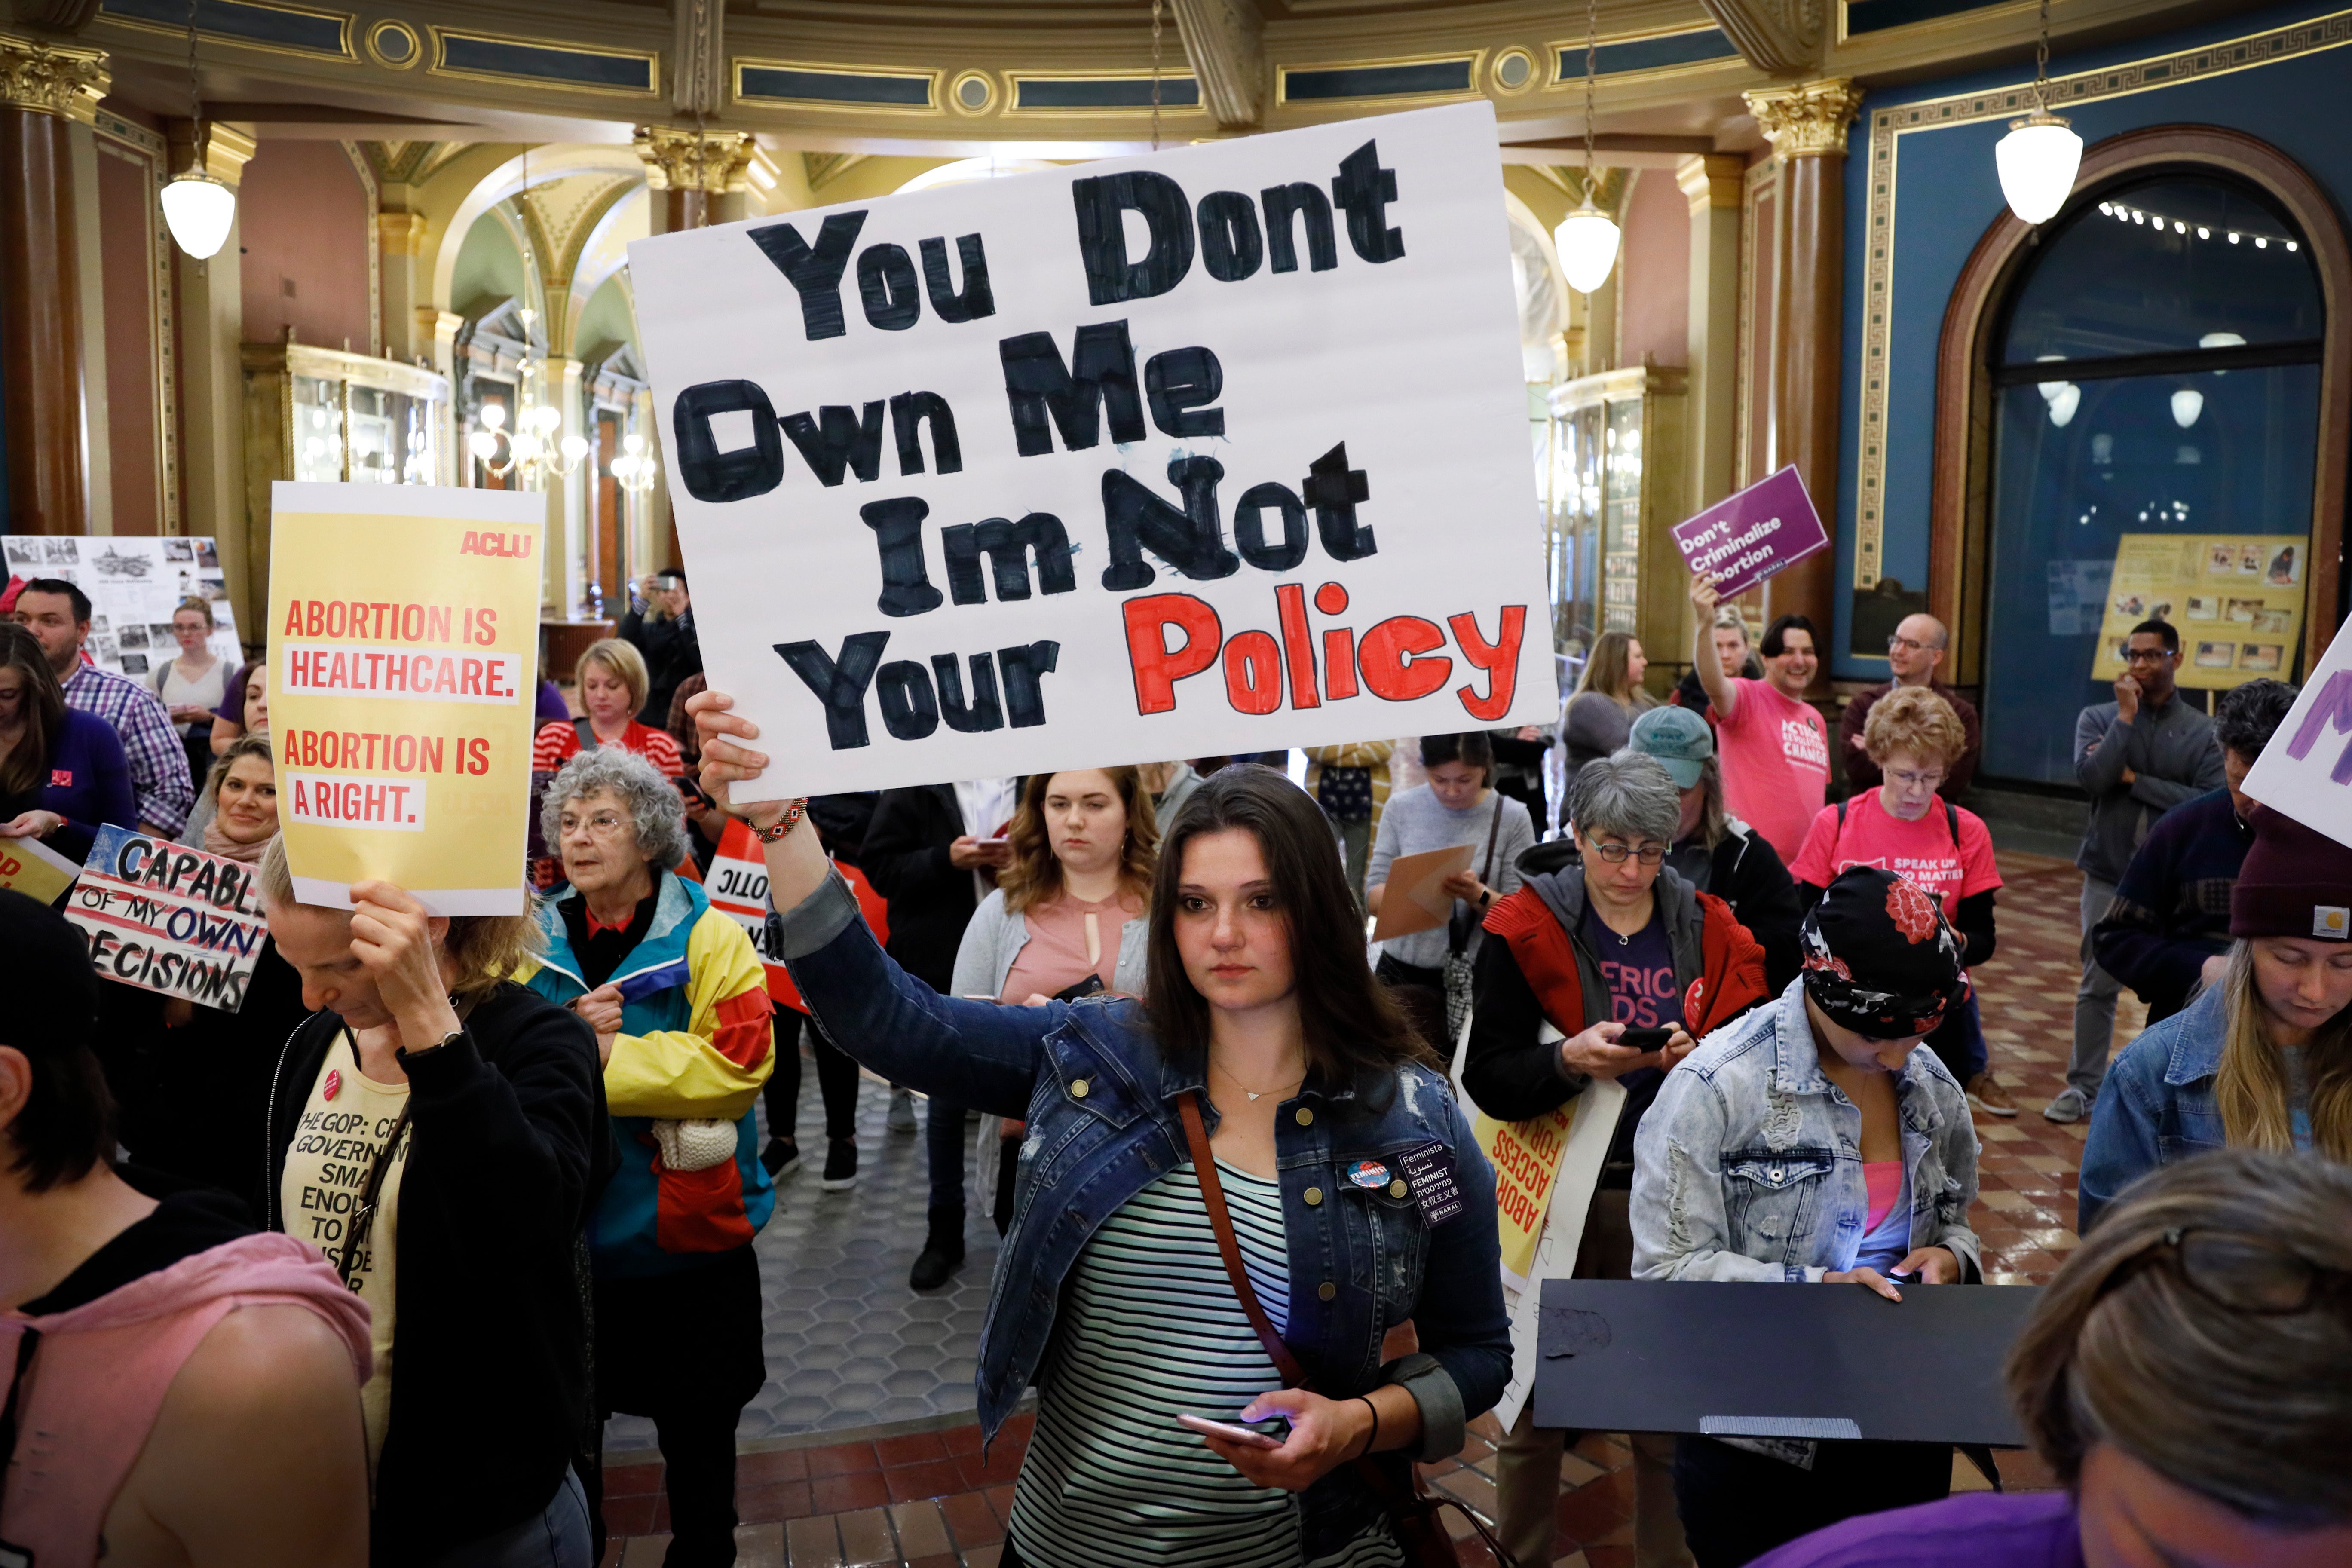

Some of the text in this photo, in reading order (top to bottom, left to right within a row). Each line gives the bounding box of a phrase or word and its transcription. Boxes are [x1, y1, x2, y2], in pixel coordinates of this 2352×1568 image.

[747, 138, 1405, 341] You Dont
[672, 319, 1225, 503] Own Me
[460, 531, 531, 558] ACLU
[860, 440, 1377, 617] Im Not
[1680, 520, 1730, 554] Don't
[1691, 517, 1782, 572] Criminalize
[1703, 544, 1774, 585] bortion
[285, 600, 497, 646] ABORTION IS
[291, 651, 513, 697] HEALTHCARE.
[772, 580, 1527, 750] Your Policy
[285, 729, 490, 775] ABORTION IS
[1784, 741, 1827, 766] CHANGE
[295, 780, 309, 816] A
[315, 781, 416, 823] RIGHT.
[118, 839, 266, 918] CAPABL
[1894, 858, 1938, 870] SPEAK
[82, 887, 260, 959] OF MY OWN
[82, 927, 250, 1012] ECISIONS
[321, 1113, 369, 1135] GOP:
[1350, 1166, 1387, 1180] FEMINIST
[1403, 1144, 1443, 1165] Feminista
[1406, 1159, 1433, 1177] نسوية
[1493, 1129, 1551, 1200] ACCESS
[1412, 1167, 1449, 1189] FEMINIST
[1416, 1178, 1452, 1198] פמיניסטית
[1421, 1186, 1459, 1209] 女权主义者
[312, 1216, 342, 1241] TO
[1439, 1204, 1459, 1215] NARAL
